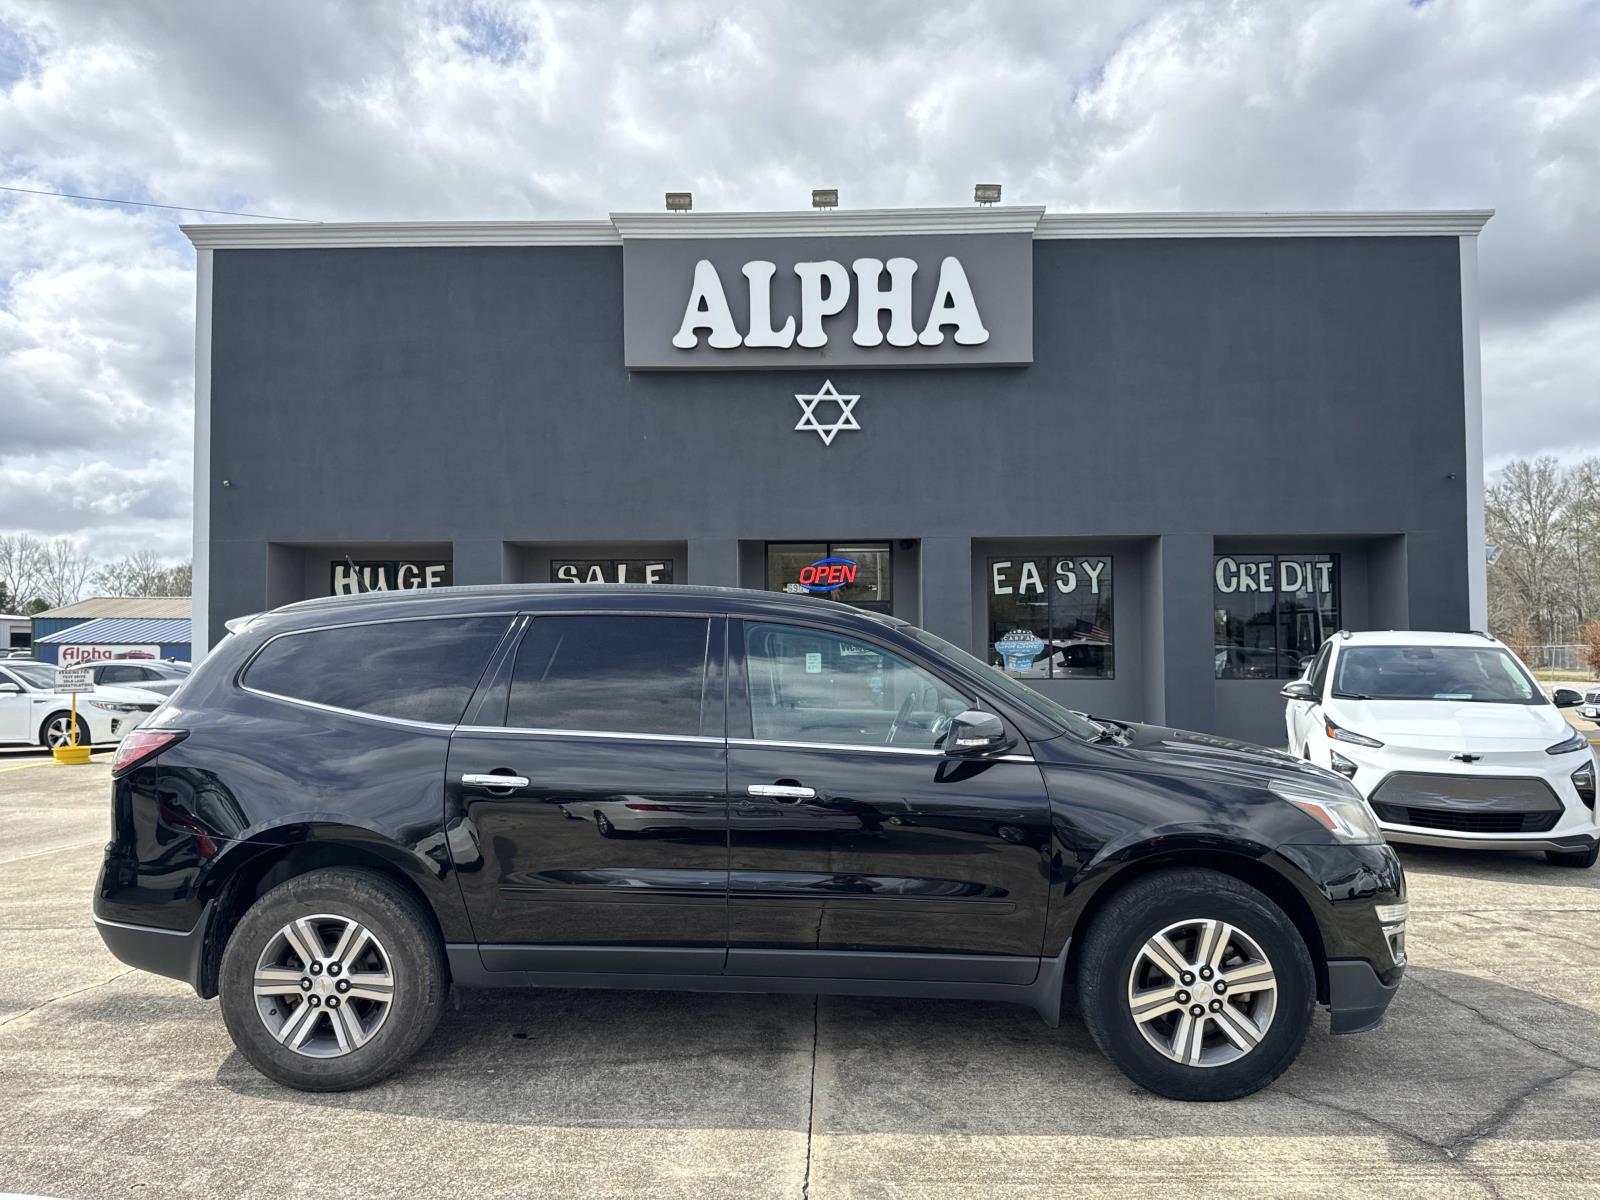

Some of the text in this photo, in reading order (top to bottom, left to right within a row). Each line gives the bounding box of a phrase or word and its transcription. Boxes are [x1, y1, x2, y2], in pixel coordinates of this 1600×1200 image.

[672, 256, 990, 349] ALPHA
[334, 564, 446, 596] HUGE
[800, 565, 857, 584] OPEN
[992, 560, 1105, 595] EASY
[1216, 557, 1333, 593] CREDIT
[63, 647, 112, 662] Alpha
